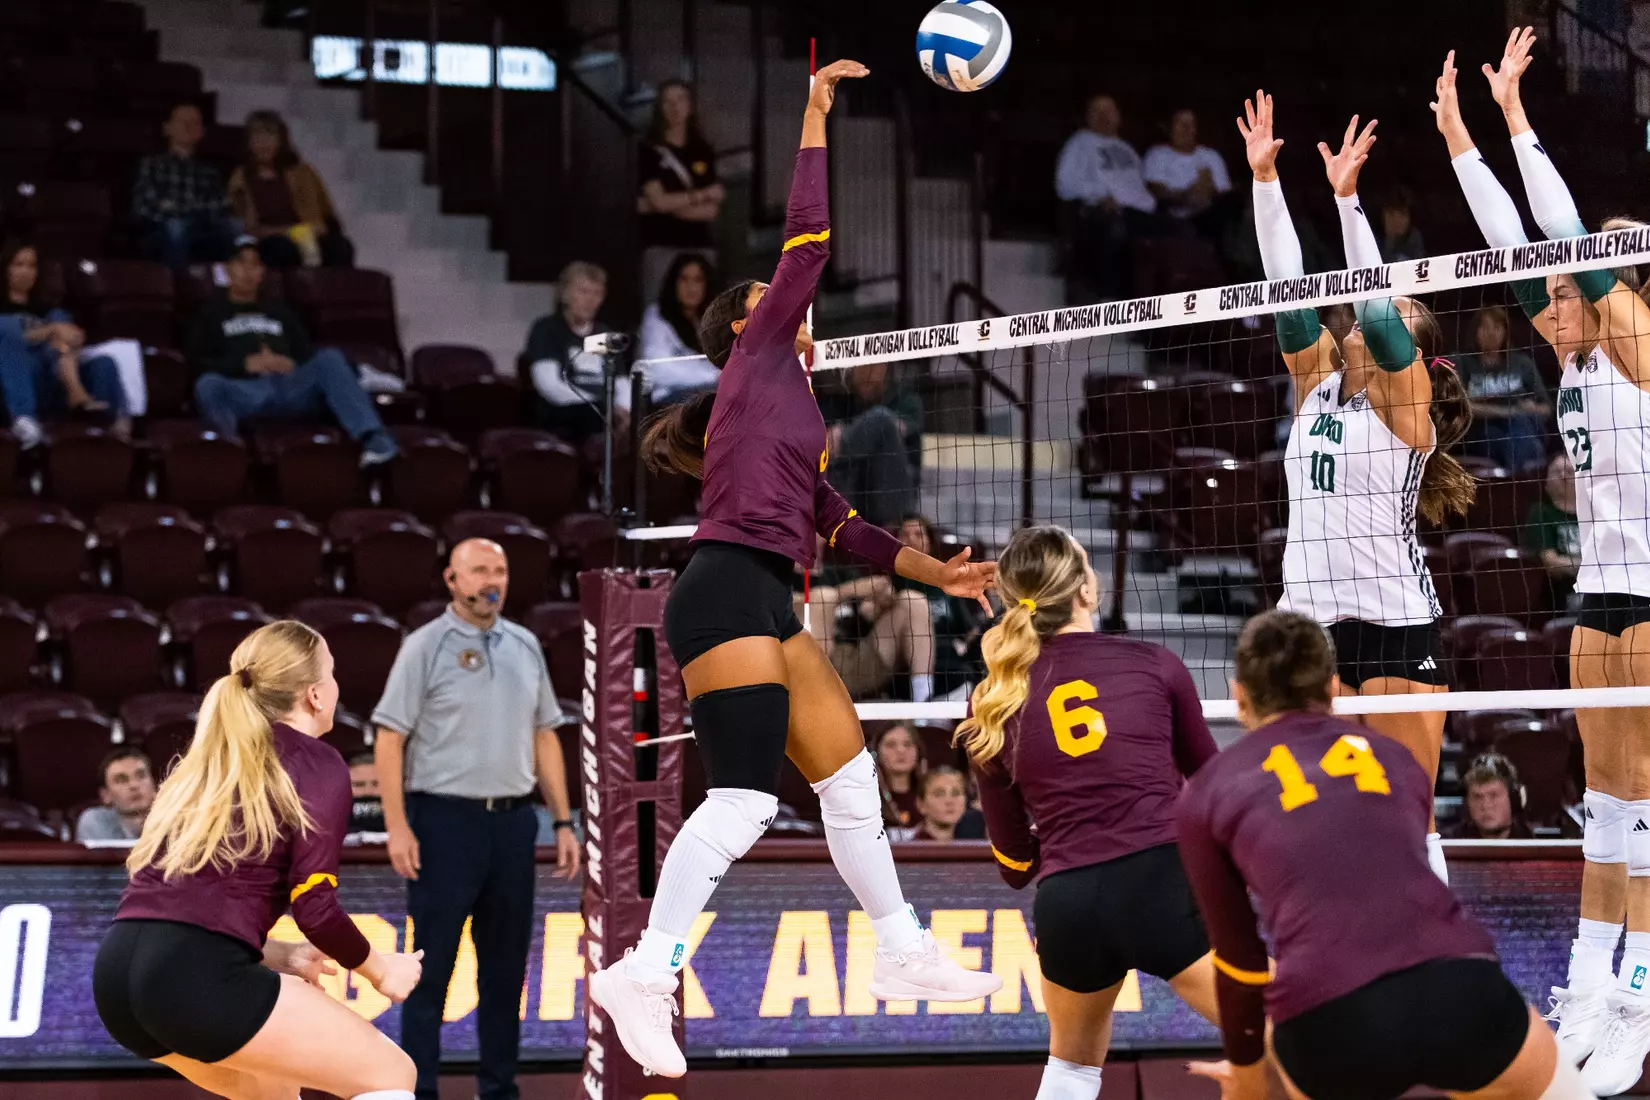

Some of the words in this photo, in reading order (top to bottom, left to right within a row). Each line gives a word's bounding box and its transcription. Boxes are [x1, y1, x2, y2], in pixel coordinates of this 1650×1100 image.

[1455, 248, 1507, 279] CENTRAL
[1511, 239, 1572, 272] MICHIGAN
[1576, 227, 1650, 262] VOLLEYBALL
[1219, 283, 1264, 311] CENTRAL
[1268, 276, 1321, 304] MICHIGAN
[1325, 266, 1392, 297] VOLLEYBALL
[1009, 314, 1050, 337] CENTRAL
[1053, 306, 1101, 332] MICHIGAN
[1104, 298, 1163, 327] VOLLEYBALL
[825, 337, 860, 360] CENTRAL
[863, 331, 905, 356] MICHIGAN
[908, 325, 960, 351] VOLLEYBALL
[1310, 450, 1336, 494] 10
[1566, 427, 1592, 472] 23
[1046, 680, 1108, 758] 6
[582, 618, 603, 886] MICHIGAN
[1262, 734, 1391, 812] 14
[583, 914, 604, 1100] ENTAL
